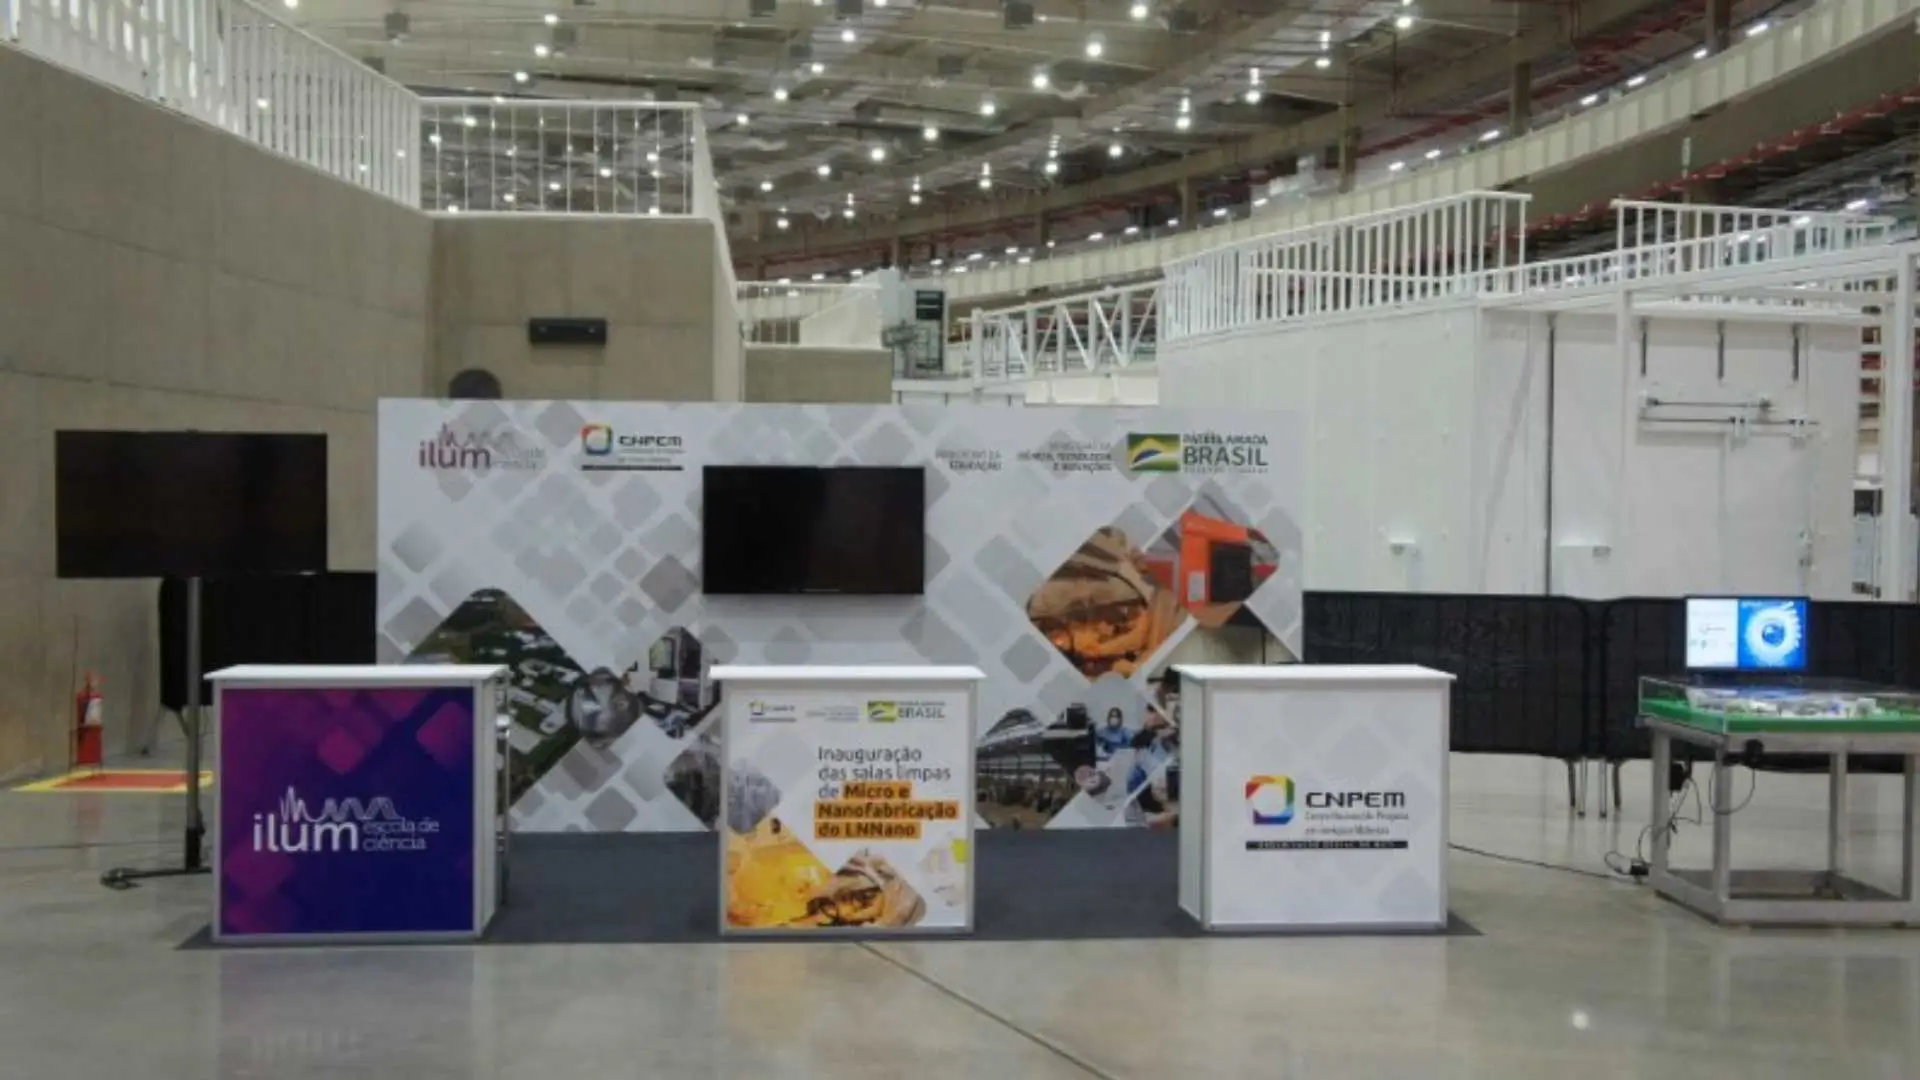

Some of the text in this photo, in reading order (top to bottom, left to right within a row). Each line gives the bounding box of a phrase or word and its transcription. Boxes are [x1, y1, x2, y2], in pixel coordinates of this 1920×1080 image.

[419, 440, 491, 469] ilum
[1183, 446, 1269, 466] BRASIL
[898, 706, 945, 719] BRASIL
[818, 746, 922, 764] Inauguração
[818, 764, 951, 782] das salas limpas
[818, 782, 911, 799] de Micro e
[1305, 792, 1405, 808] CNPEM
[818, 802, 957, 821] Nanofabricação
[253, 813, 358, 852] ilum
[363, 817, 440, 834] escola de
[818, 822, 915, 837] do LNNano
[363, 835, 427, 851] ciência
